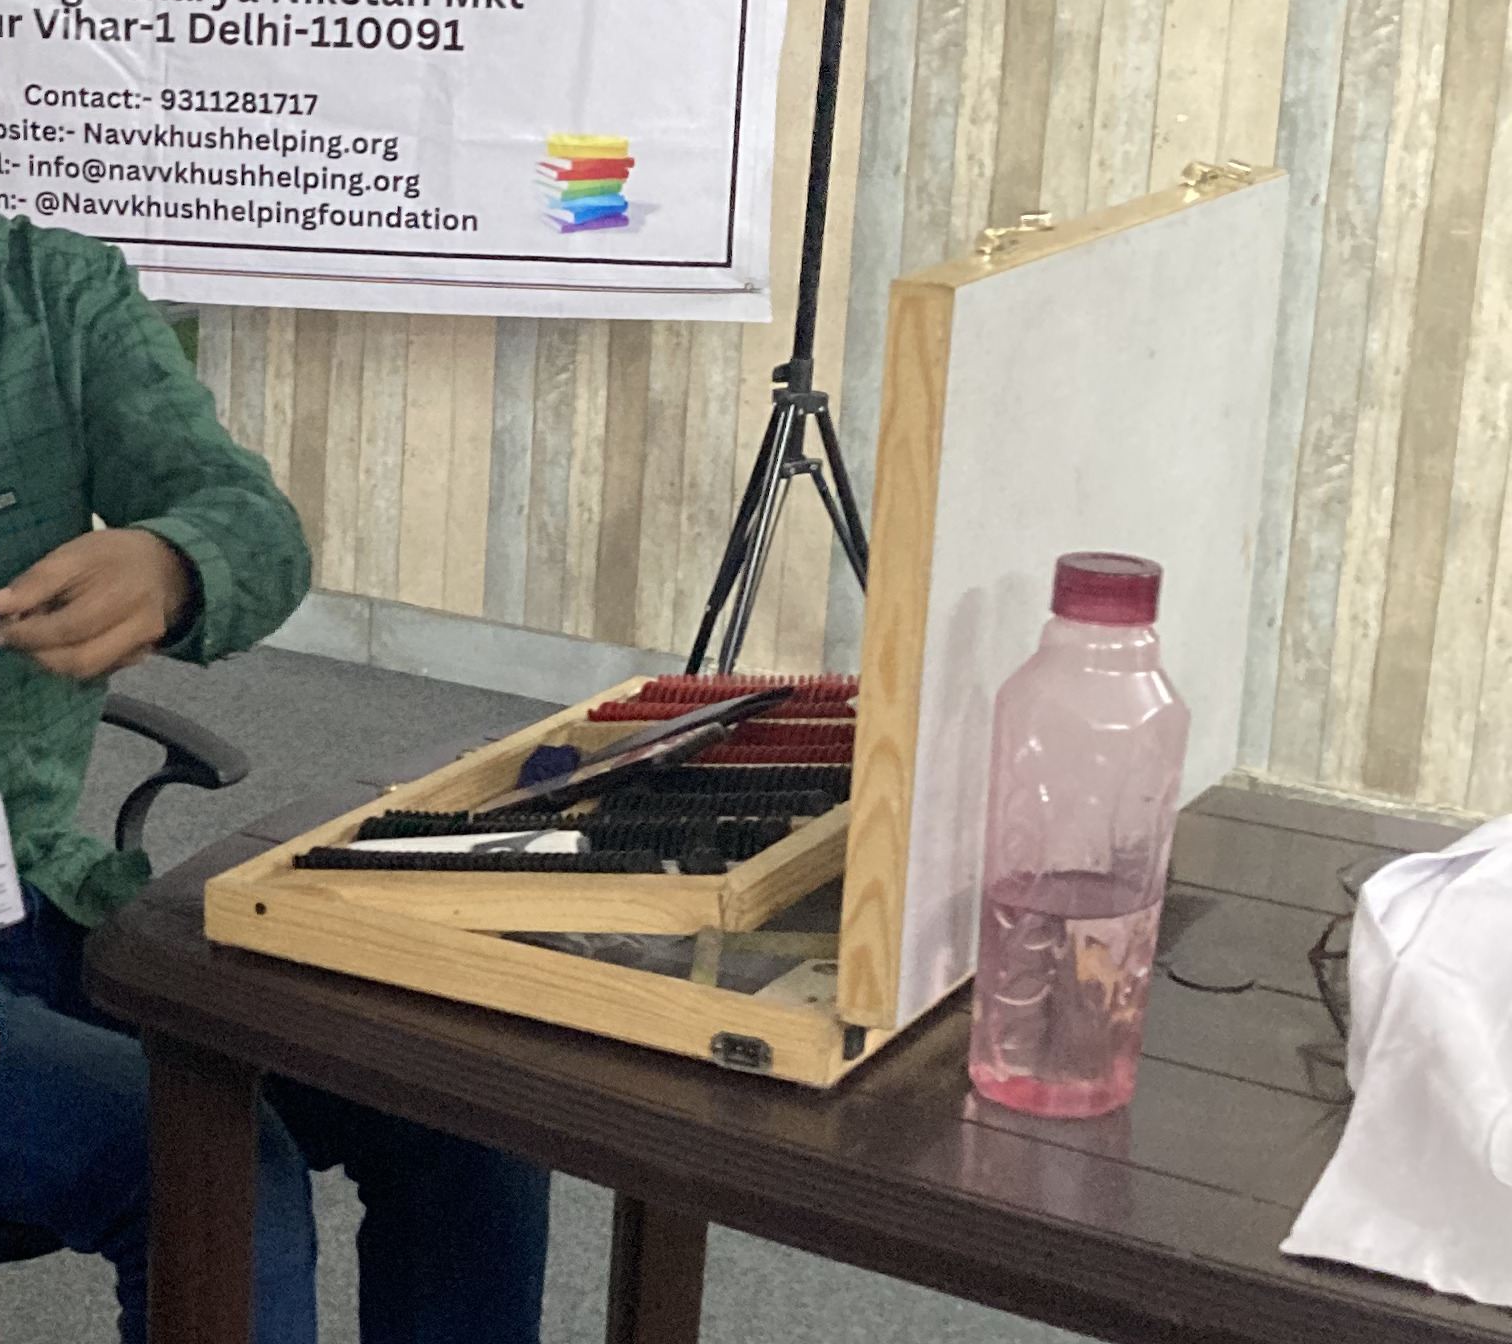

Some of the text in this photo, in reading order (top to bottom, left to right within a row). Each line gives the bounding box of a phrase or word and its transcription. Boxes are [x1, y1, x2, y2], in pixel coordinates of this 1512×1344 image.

[33, 7, 176, 43] Vihar-1
[188, 12, 465, 52] Delhi-110091
[24, 84, 319, 116] Contact:- 9311281717
[83, 122, 399, 162] Navvkhushhelping.org
[28, 155, 421, 199] info@navvkhushhelping.org
[35, 191, 479, 232] @Navvkhushhelpingfoundation
